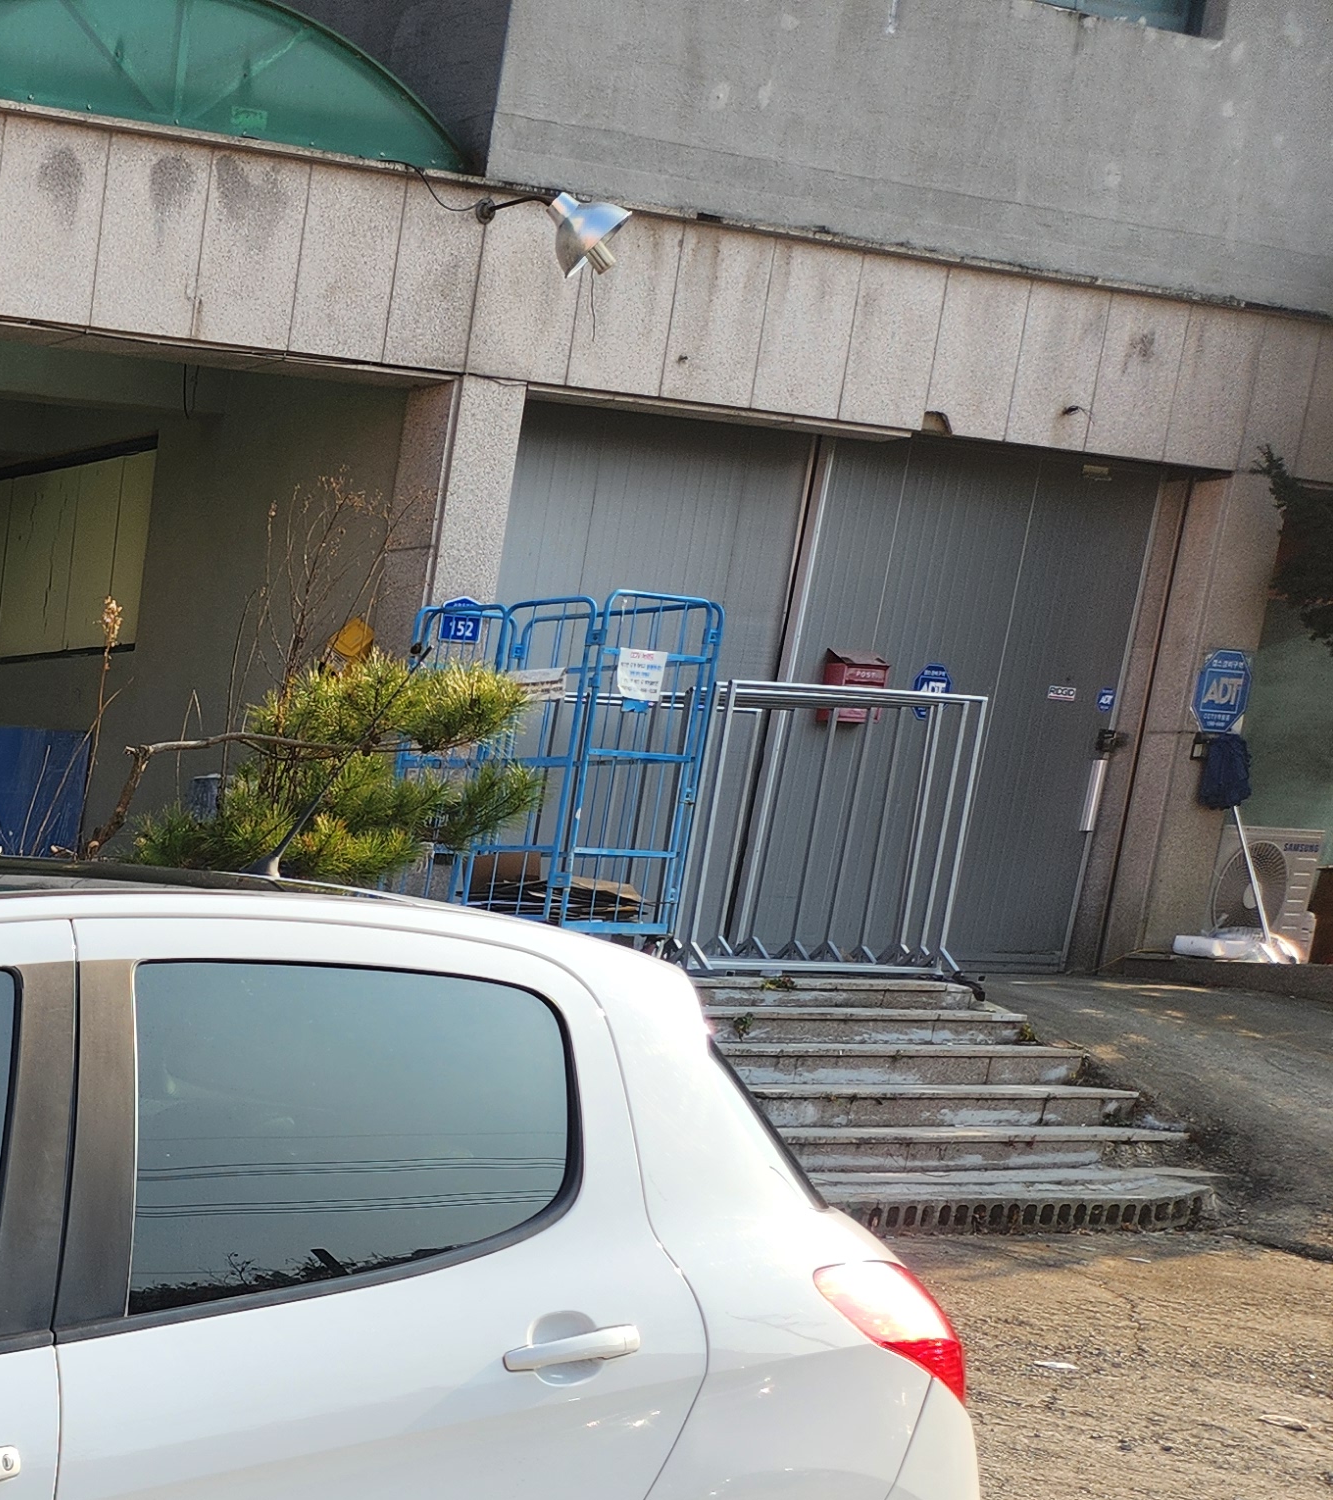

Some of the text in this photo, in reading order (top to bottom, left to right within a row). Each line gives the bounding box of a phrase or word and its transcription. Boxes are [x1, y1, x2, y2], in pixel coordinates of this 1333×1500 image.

[449, 621, 474, 637] 152
[856, 670, 876, 679] POST
[920, 681, 947, 693] ADT
[1201, 677, 1242, 705] ADT
[1098, 695, 1114, 705] ADT
[1283, 842, 1319, 853] SAMSUNG
